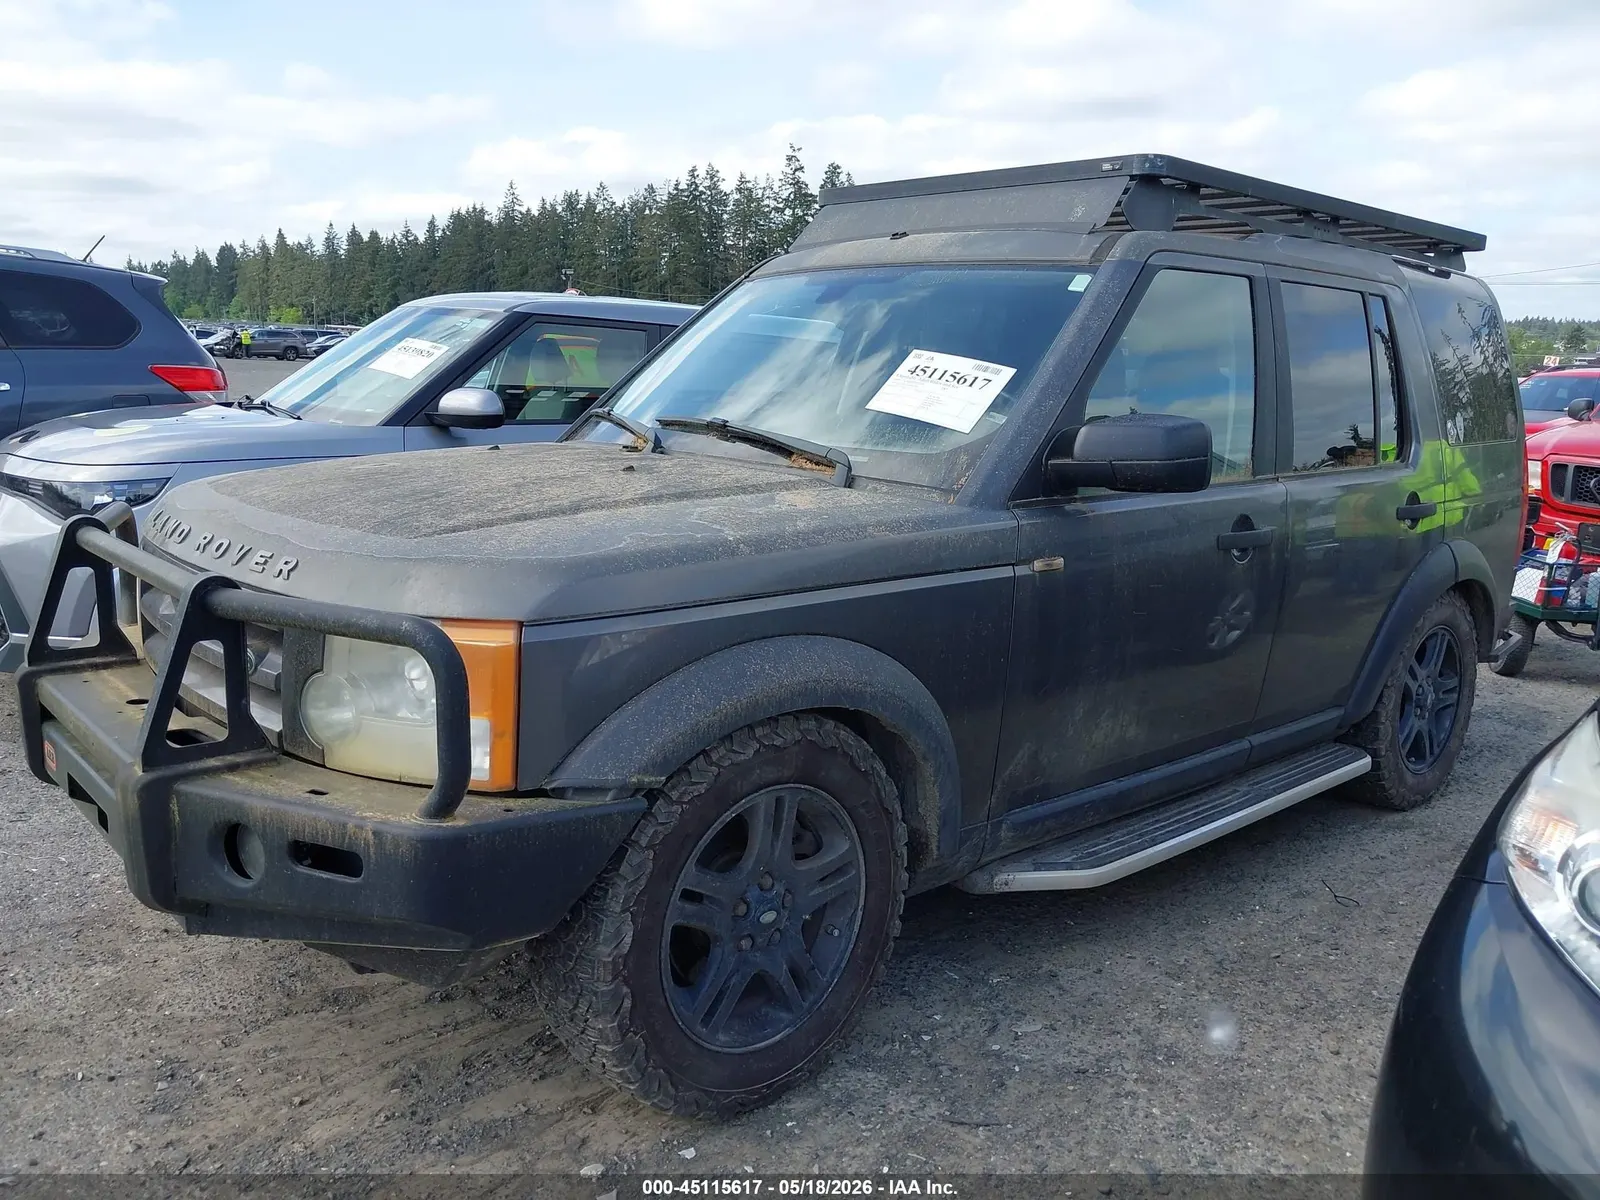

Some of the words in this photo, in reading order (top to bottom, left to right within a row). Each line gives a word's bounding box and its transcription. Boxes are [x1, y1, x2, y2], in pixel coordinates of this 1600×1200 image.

[907, 364, 993, 390] 45115617
[152, 509, 191, 544] LAND
[195, 531, 299, 580] ROVER
